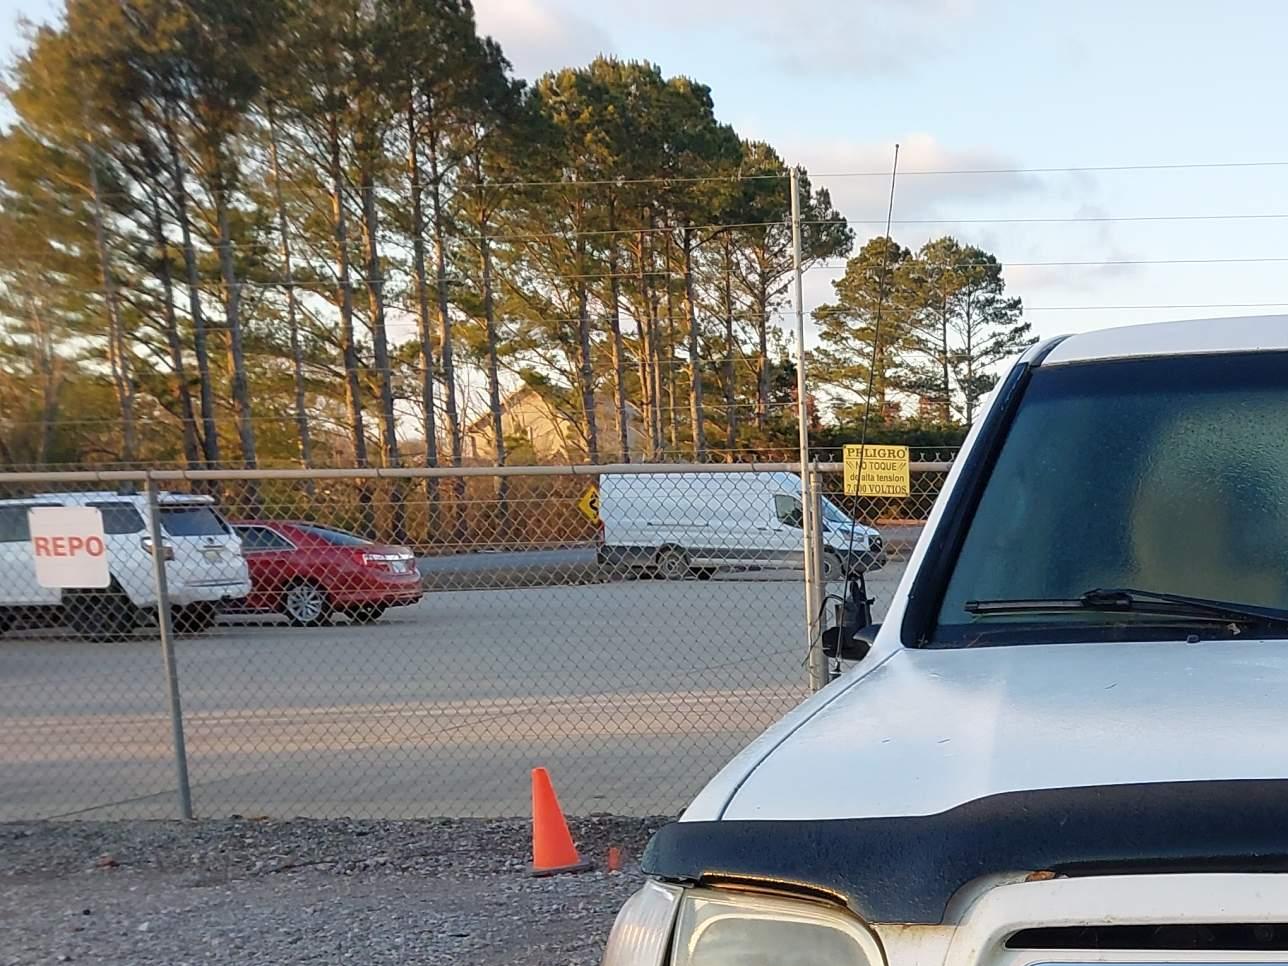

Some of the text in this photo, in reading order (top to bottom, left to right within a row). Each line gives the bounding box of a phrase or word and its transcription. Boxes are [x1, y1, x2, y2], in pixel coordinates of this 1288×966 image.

[869, 462, 897, 471] TOQUE
[861, 473, 875, 482] alta
[869, 484, 907, 495] VOLTIOS
[34, 536, 104, 557] REPO
